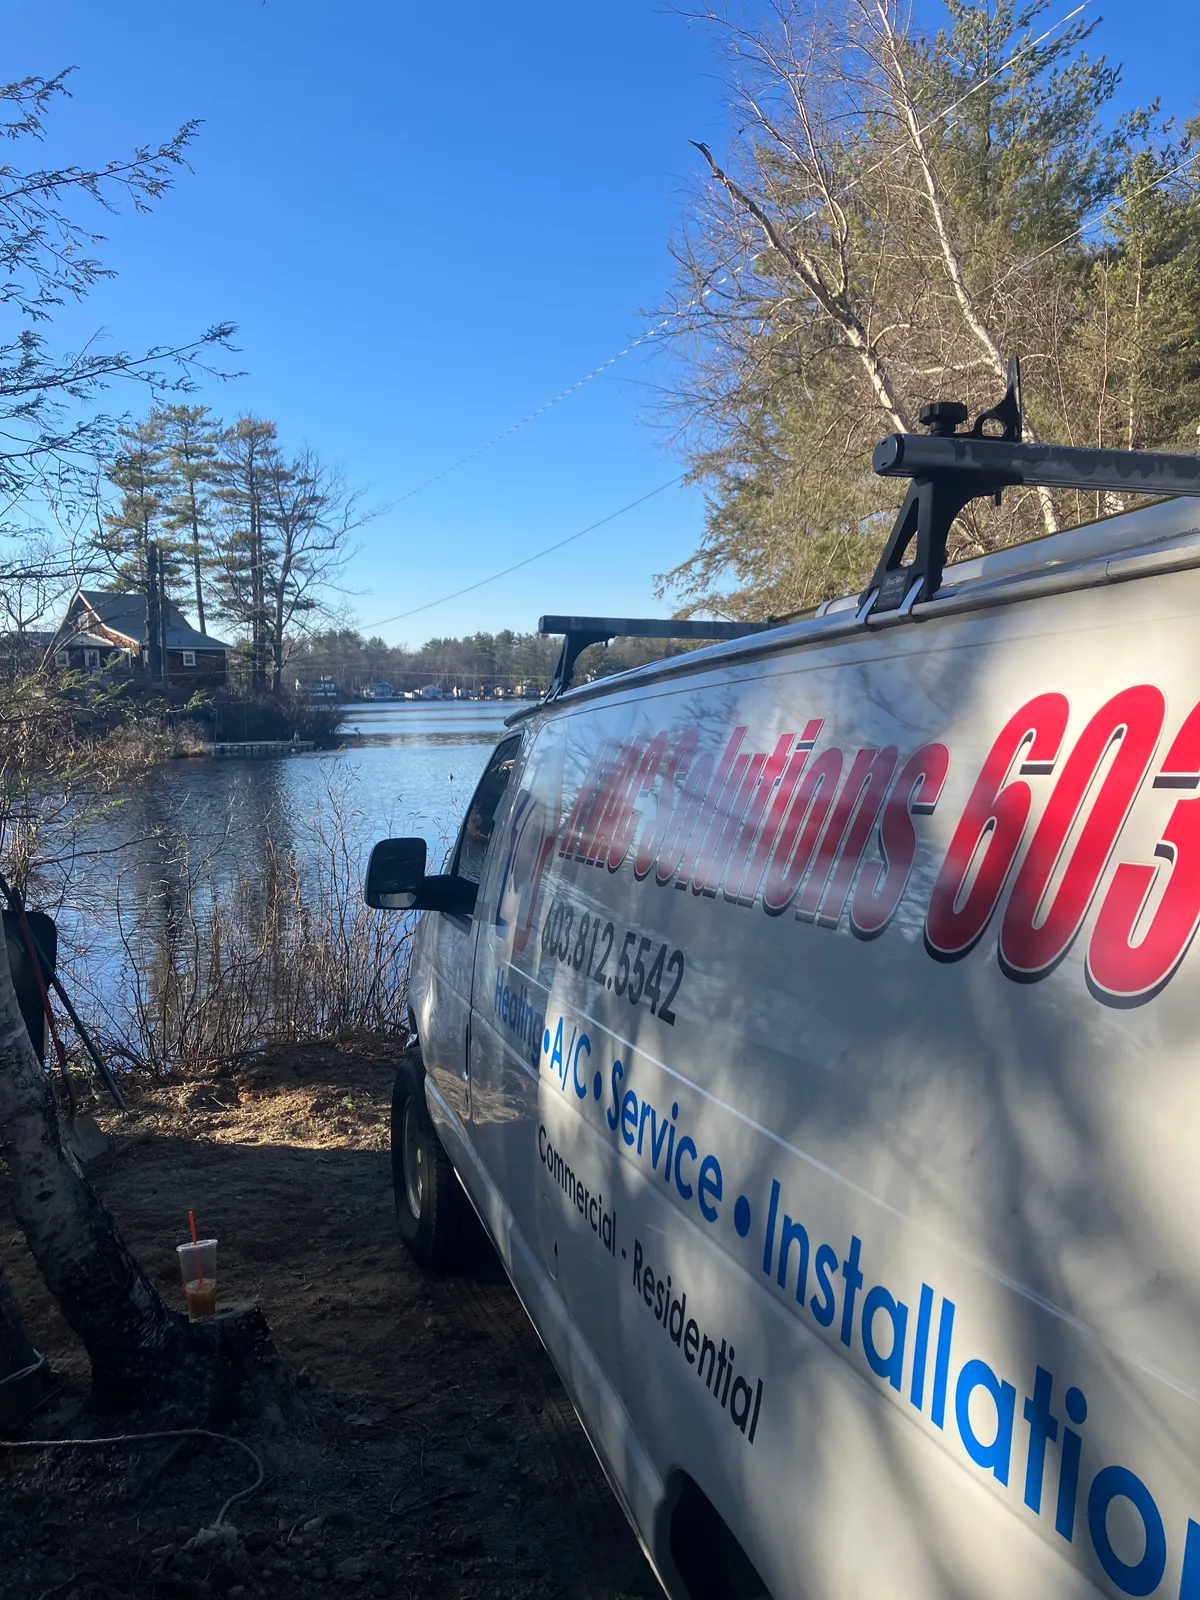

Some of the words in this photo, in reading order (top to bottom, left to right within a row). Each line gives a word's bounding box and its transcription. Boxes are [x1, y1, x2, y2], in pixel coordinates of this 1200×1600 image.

[541, 900, 685, 1027] 603.812.5542
[634, 717, 950, 942] Solutions
[495, 966, 544, 1070] Heating
[549, 1016, 592, 1099] A/C
[607, 1060, 722, 1222] Service
[763, 1179, 1200, 1600] Installatio
[538, 1124, 616, 1258] Commercial
[633, 1238, 764, 1445] Residential
